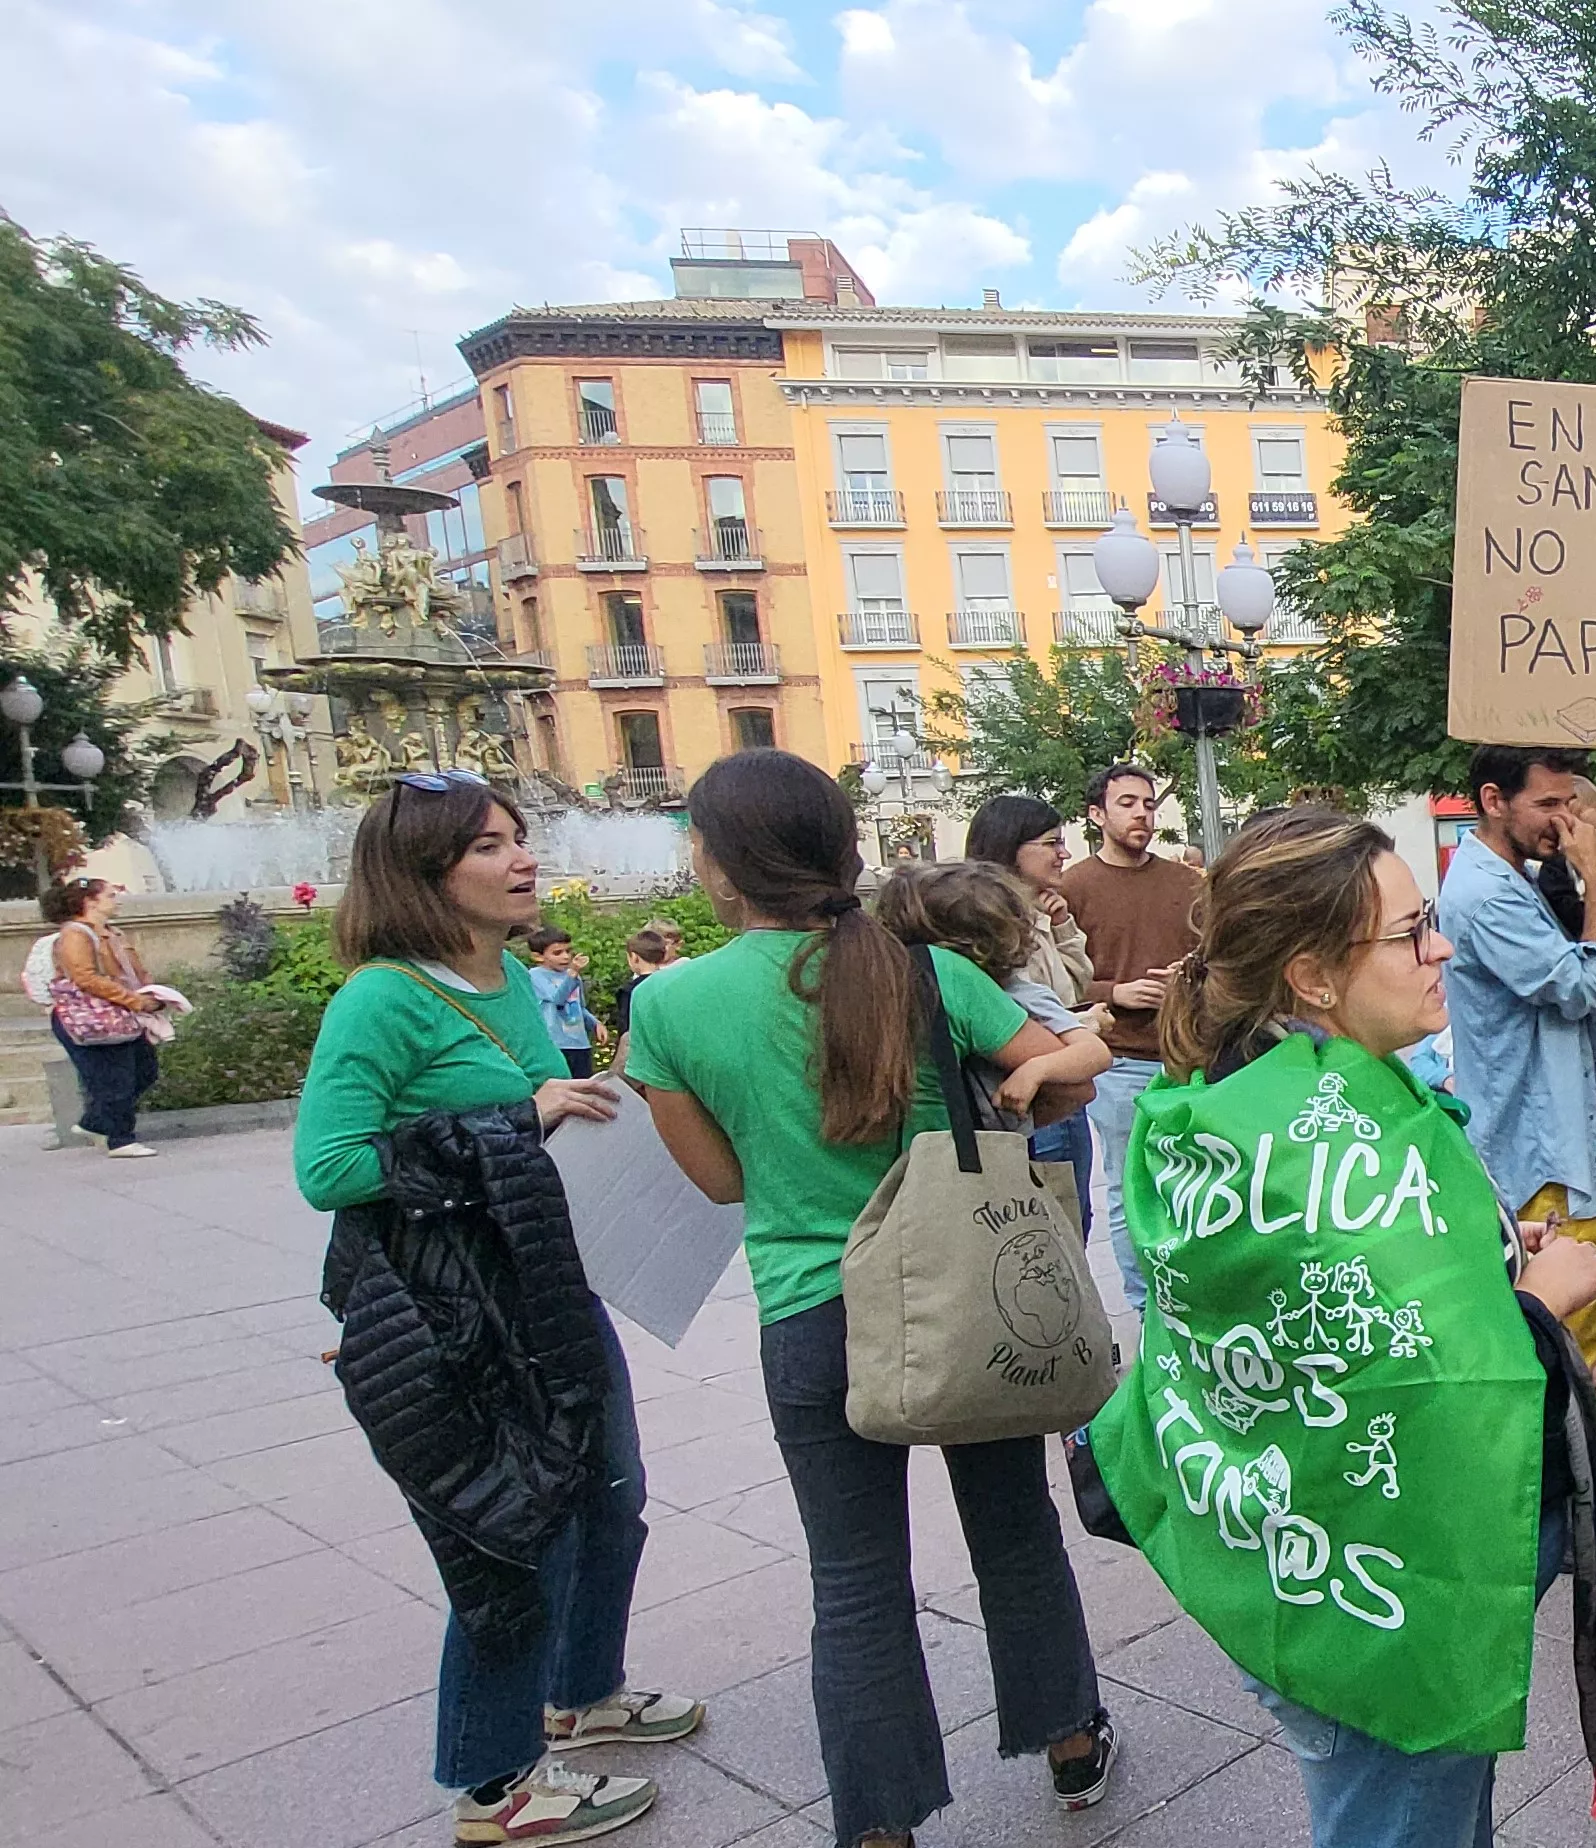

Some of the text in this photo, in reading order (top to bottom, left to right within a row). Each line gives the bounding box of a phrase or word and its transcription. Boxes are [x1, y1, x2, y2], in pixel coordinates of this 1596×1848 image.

[1508, 400, 1583, 452] EN
[1251, 501, 1270, 513] 611
[1484, 526, 1566, 576] NO
[986, 1336, 1093, 1387] Planet B
